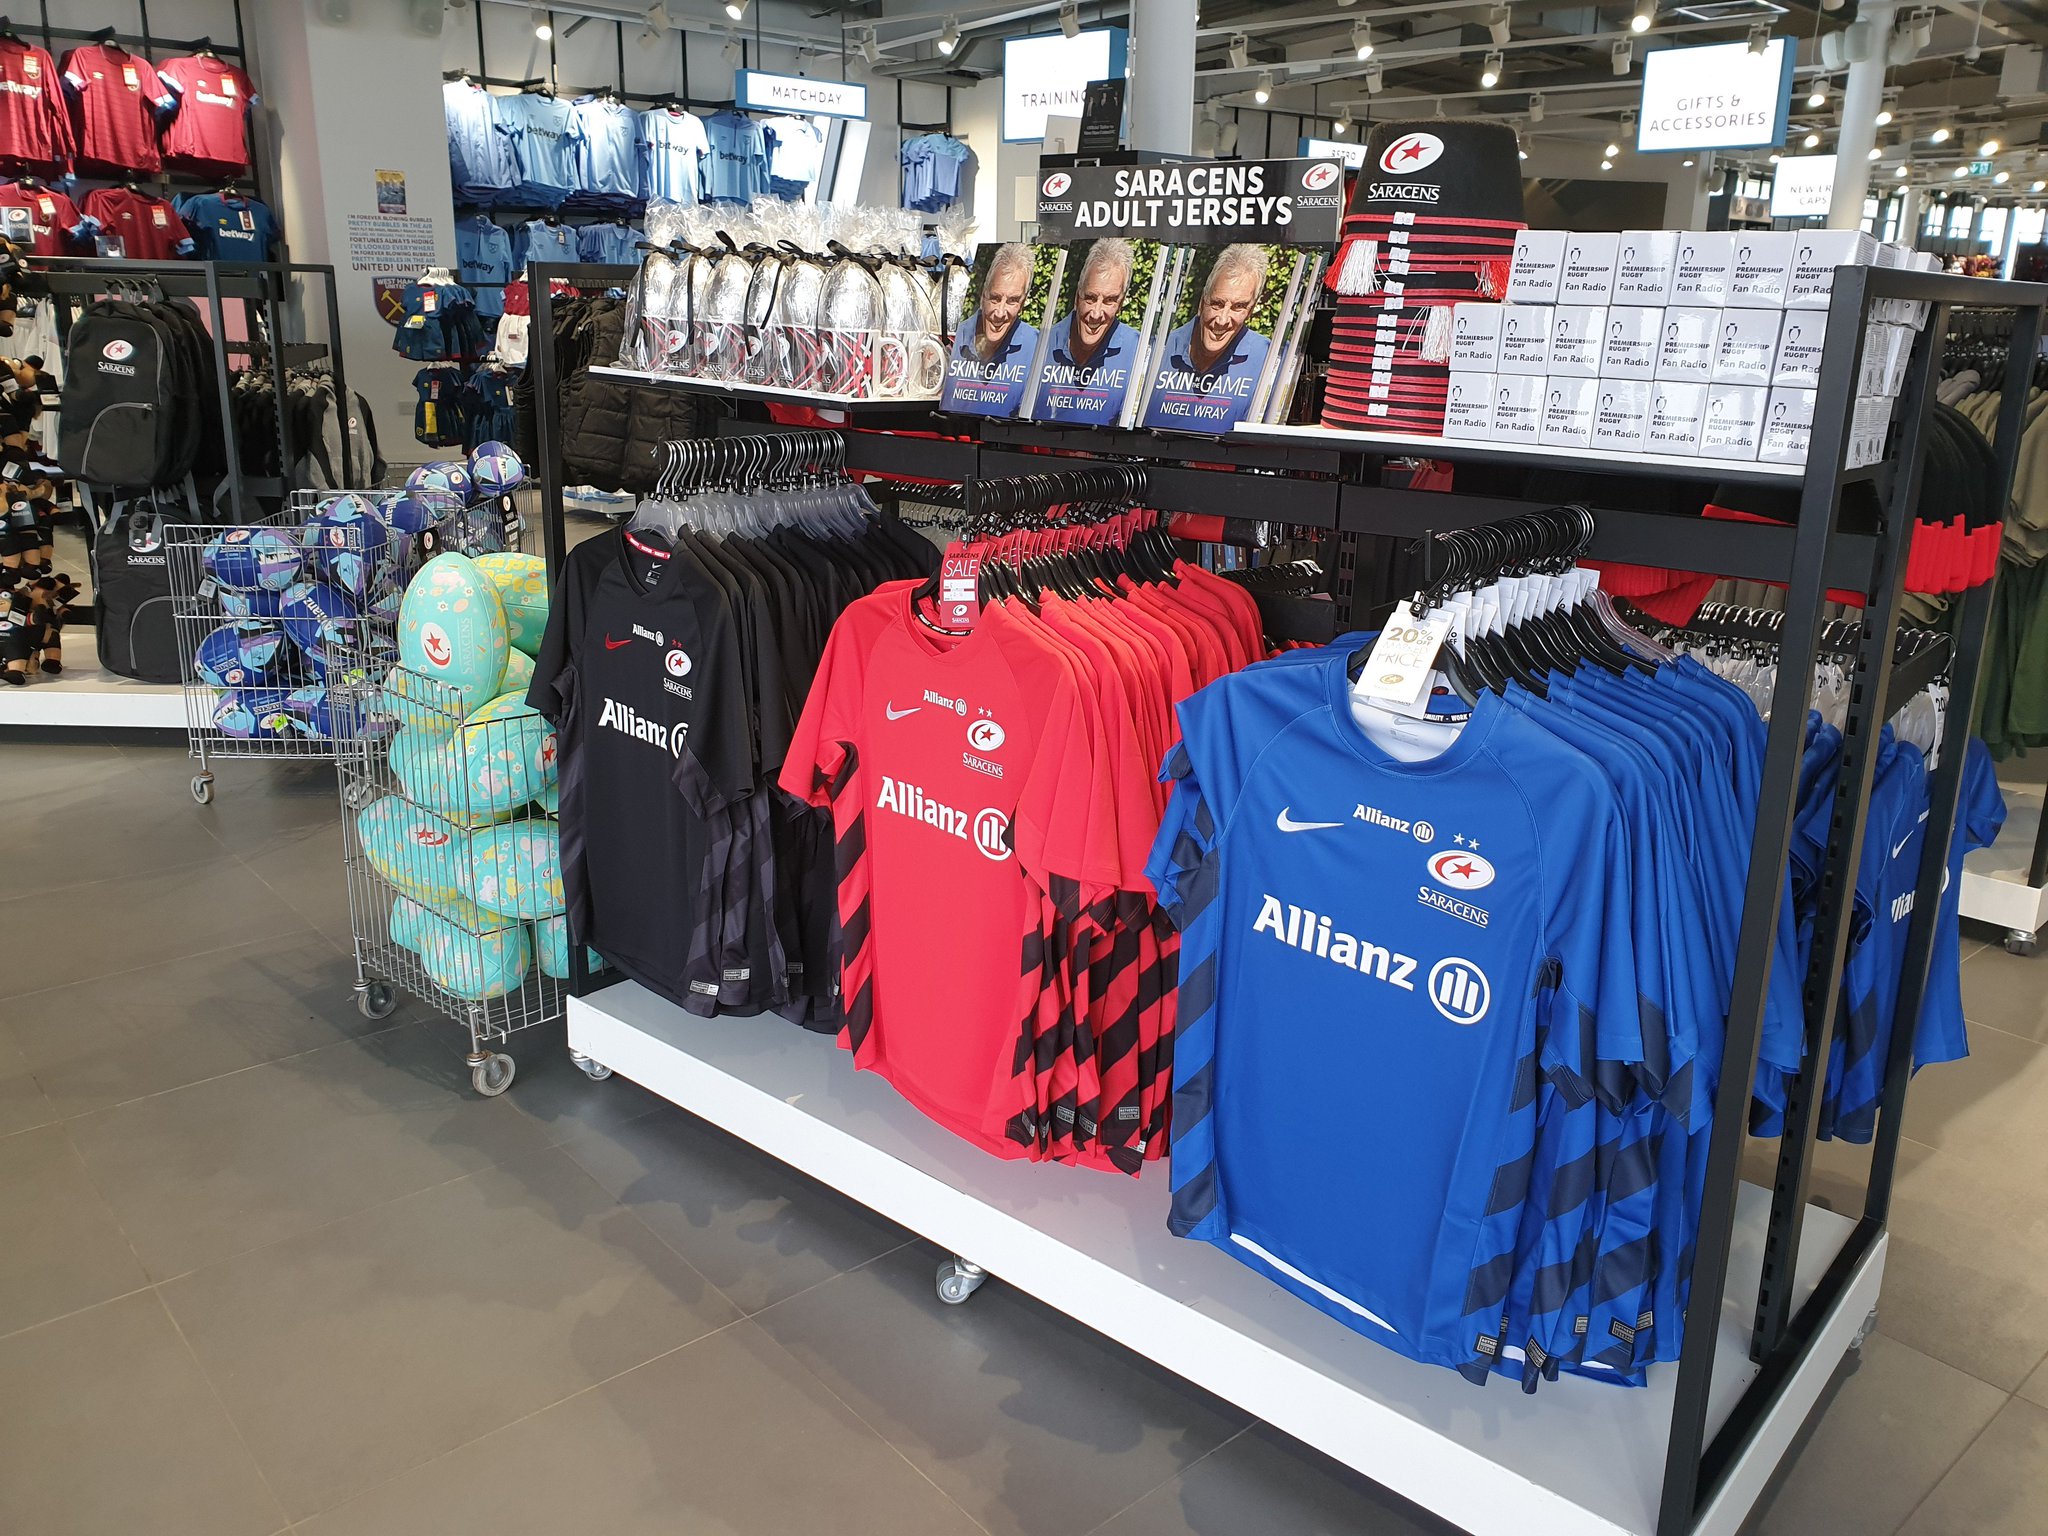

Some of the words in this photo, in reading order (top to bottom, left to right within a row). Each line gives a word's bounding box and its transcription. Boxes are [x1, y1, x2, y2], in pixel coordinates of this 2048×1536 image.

[0, 80, 42, 98] etway
[772, 86, 843, 105] MATCHDAY
[1677, 96, 1725, 111] GIFTS
[1731, 94, 1741, 107] &
[1650, 112, 1767, 131] ACCESSORIES
[526, 126, 562, 142] betway
[719, 151, 749, 165] betway
[1114, 166, 1265, 198] SARACENS
[1368, 182, 1441, 204] SARACENS
[1297, 194, 1339, 208] SARACENS
[1039, 201, 1073, 213] SARACENS
[1074, 200, 1164, 228] ADULT
[1168, 195, 1294, 227] JERSEYS
[218, 228, 255, 242] betway
[352, 263, 394, 271] UNITED!
[462, 259, 495, 274] betway
[1515, 262, 1556, 270] PREMIERSHIP
[1568, 265, 1610, 273] PREMIERSHIP
[1736, 266, 1785, 274] PREMIERSHIP
[1514, 268, 1536, 276] RUGBY
[1735, 272, 1760, 280] RUGBY
[1795, 272, 1821, 280] RUGBY
[1512, 279, 1527, 288] Fan
[1530, 280, 1553, 288] Radio
[1565, 283, 1580, 291] Fan
[1583, 283, 1607, 292] Radio
[1619, 283, 1635, 291] Fan
[1638, 284, 1664, 293] Radio
[1676, 283, 1693, 292] Fan
[1695, 284, 1723, 293] Radio
[1733, 284, 1749, 293] Fan
[1752, 285, 1781, 294] Radio
[1792, 285, 1809, 294] Fan
[1456, 334, 1494, 342] PREMIERSHIP
[1506, 336, 1546, 344] PREMIERSHIP
[1609, 339, 1653, 347] PREMIERSHIP
[1454, 351, 1468, 359] Fan
[1470, 352, 1493, 360] Radio
[1503, 353, 1518, 361] Fan
[1520, 354, 1544, 362] Radio
[1553, 354, 1568, 362] Fan
[1571, 355, 1596, 364] Radio
[1784, 351, 1809, 359] RUGBY
[1606, 356, 1622, 365] Fan
[1624, 358, 1650, 367] Radio
[1662, 358, 1678, 368] Fan
[1680, 360, 1708, 369] Radio
[98, 361, 136, 377] SARACENS
[947, 359, 980, 379] SKIN
[984, 362, 1027, 383] GAME
[1781, 363, 1797, 372] Fan
[1041, 364, 1076, 384] SKIN
[1080, 367, 1127, 389] GAME
[1155, 370, 1196, 391] SKIN
[1200, 373, 1253, 397] GAME
[953, 388, 979, 401] NIGEL
[980, 390, 1008, 404] WRAY
[1046, 395, 1075, 409] NIGEL
[1076, 397, 1107, 411] WRAY
[1450, 402, 1489, 410] PREMIERSHIP
[1160, 402, 1192, 416] NIGEL
[1194, 405, 1229, 420] WRAY
[1600, 411, 1643, 420] PREMIERSHIP
[1448, 418, 1462, 427] Fan
[1464, 418, 1487, 428] Radio
[1653, 414, 1698, 423] PREMIERSHIP
[1495, 422, 1509, 430] Fan
[1511, 423, 1535, 432] Radio
[1545, 424, 1560, 433] Fan
[1562, 426, 1587, 435] Radio
[1597, 428, 1612, 437] Fan
[1615, 429, 1641, 439] Radio
[1650, 431, 1666, 441] Fan
[1669, 432, 1695, 443] Radio
[1766, 438, 1783, 448] Fan
[961, 533, 968, 541] S
[127, 555, 167, 566] SARACENS
[949, 552, 980, 560] SARACENS
[944, 559, 979, 578] SALE
[1413, 604, 1422, 612] S
[1429, 600, 1437, 608] S
[632, 623, 657, 641] Allianz
[1375, 652, 1423, 669] PRICE
[663, 677, 693, 700] SARACENS
[923, 688, 955, 710] Allianz
[598, 697, 669, 751] Allianz
[963, 751, 1004, 779] SARACENS
[877, 775, 969, 841] Allianz
[1352, 803, 1411, 834] Allianz
[1417, 885, 1490, 929] SARACENS
[1252, 893, 1419, 992] Allianz
